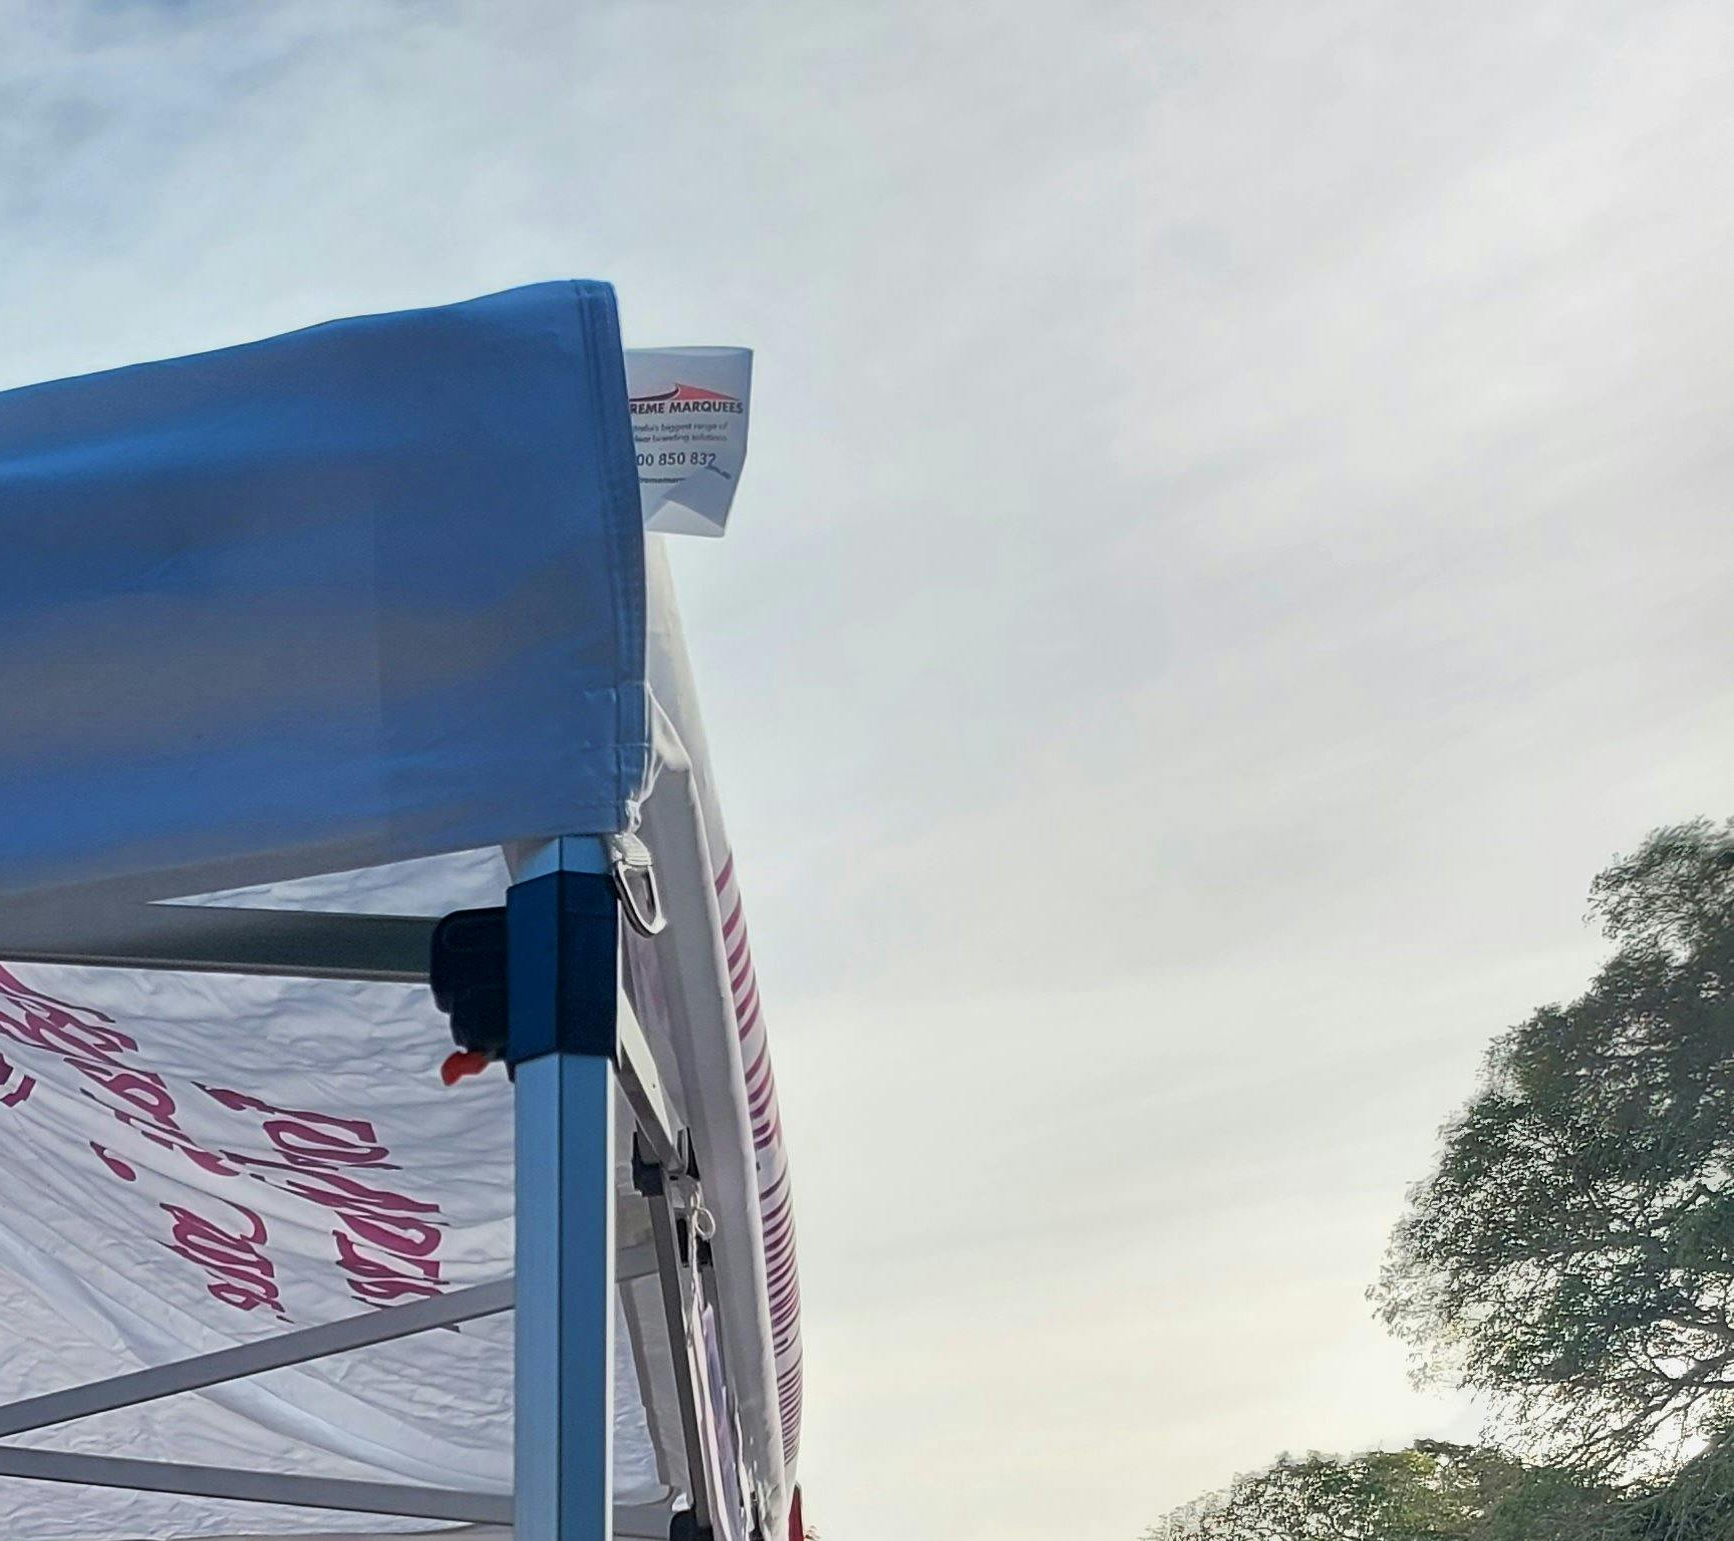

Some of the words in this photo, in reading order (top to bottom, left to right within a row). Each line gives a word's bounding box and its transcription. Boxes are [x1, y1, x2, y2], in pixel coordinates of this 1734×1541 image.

[630, 402, 665, 414] REME
[669, 401, 743, 414] MARQUEES
[637, 454, 654, 467] 00
[658, 452, 685, 466] 850
